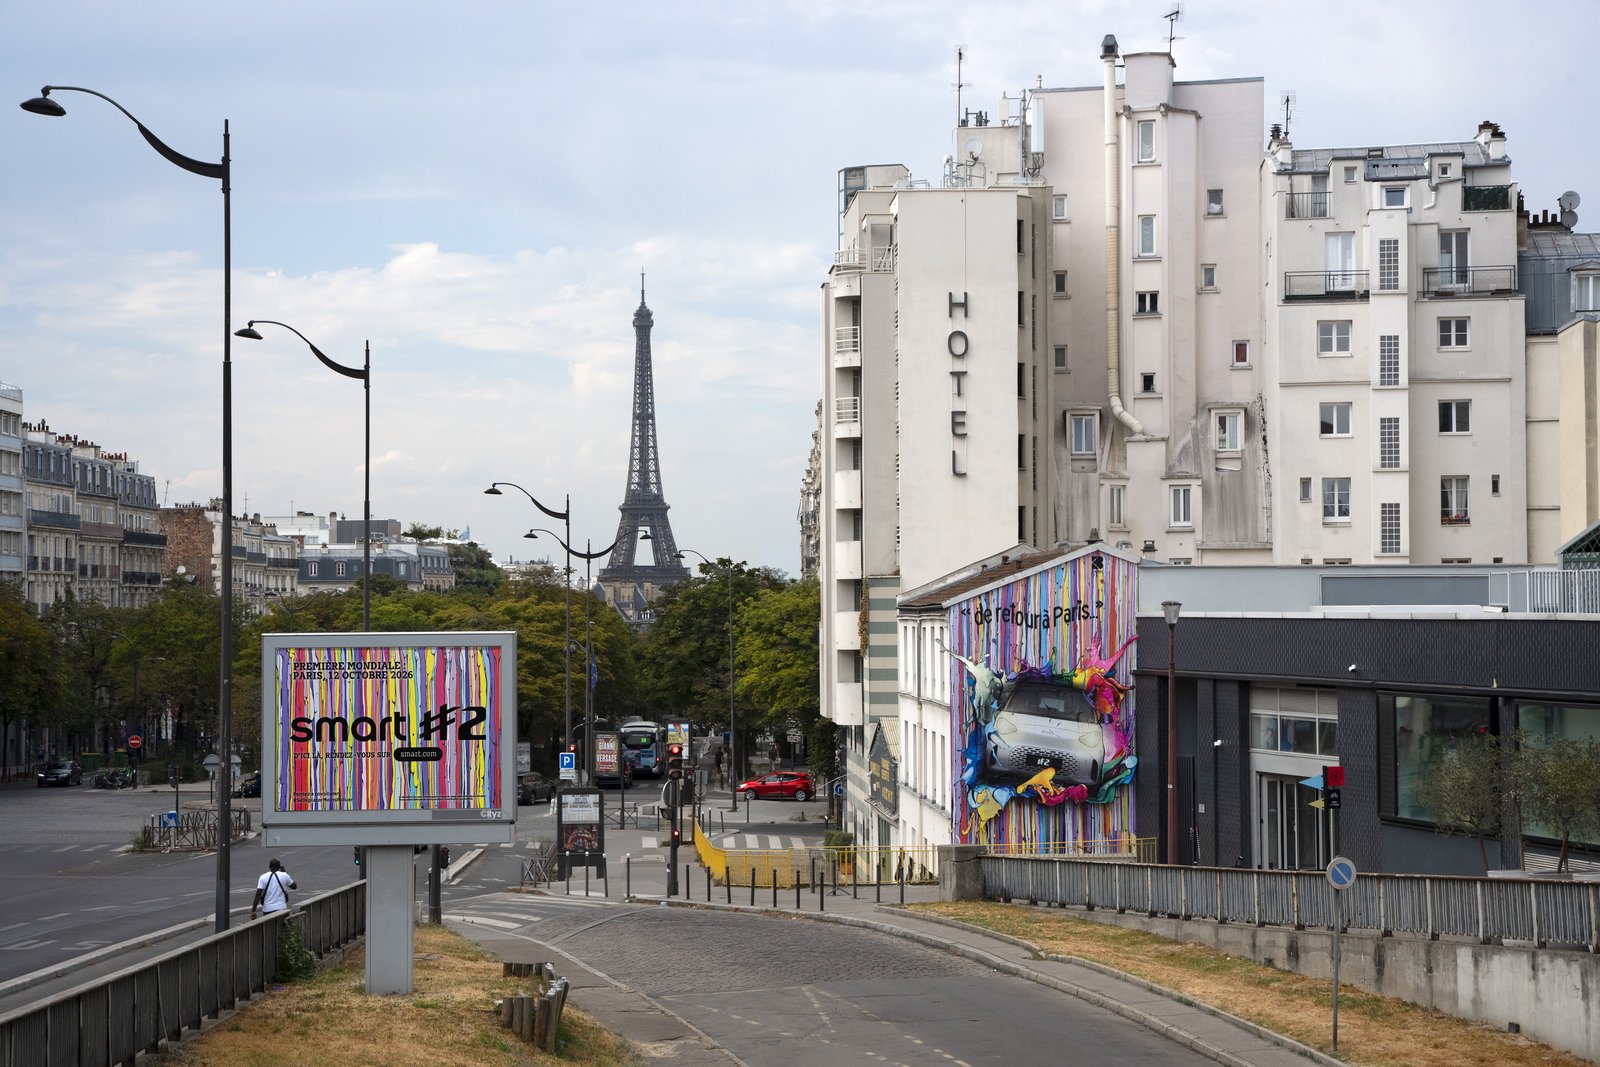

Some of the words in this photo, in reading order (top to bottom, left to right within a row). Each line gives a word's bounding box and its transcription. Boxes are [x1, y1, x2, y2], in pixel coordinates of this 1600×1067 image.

[947, 291, 969, 477] HOTEL
[974, 602, 993, 626] de
[995, 602, 1040, 630] retour
[1042, 609, 1050, 629] à
[293, 660, 345, 671] PREMIÈRE
[347, 661, 401, 670] MONDIALE
[293, 671, 326, 681] PARIS,
[328, 671, 340, 679] 12
[342, 671, 388, 679] OCTOBRE
[390, 671, 414, 679] 2026
[290, 711, 407, 743] smart
[419, 703, 487, 740] #2
[312, 750, 324, 760] LÀ,
[325, 751, 376, 759] RENDEZ-VOUS
[400, 750, 438, 758] smart.com
[563, 756, 570, 766] P
